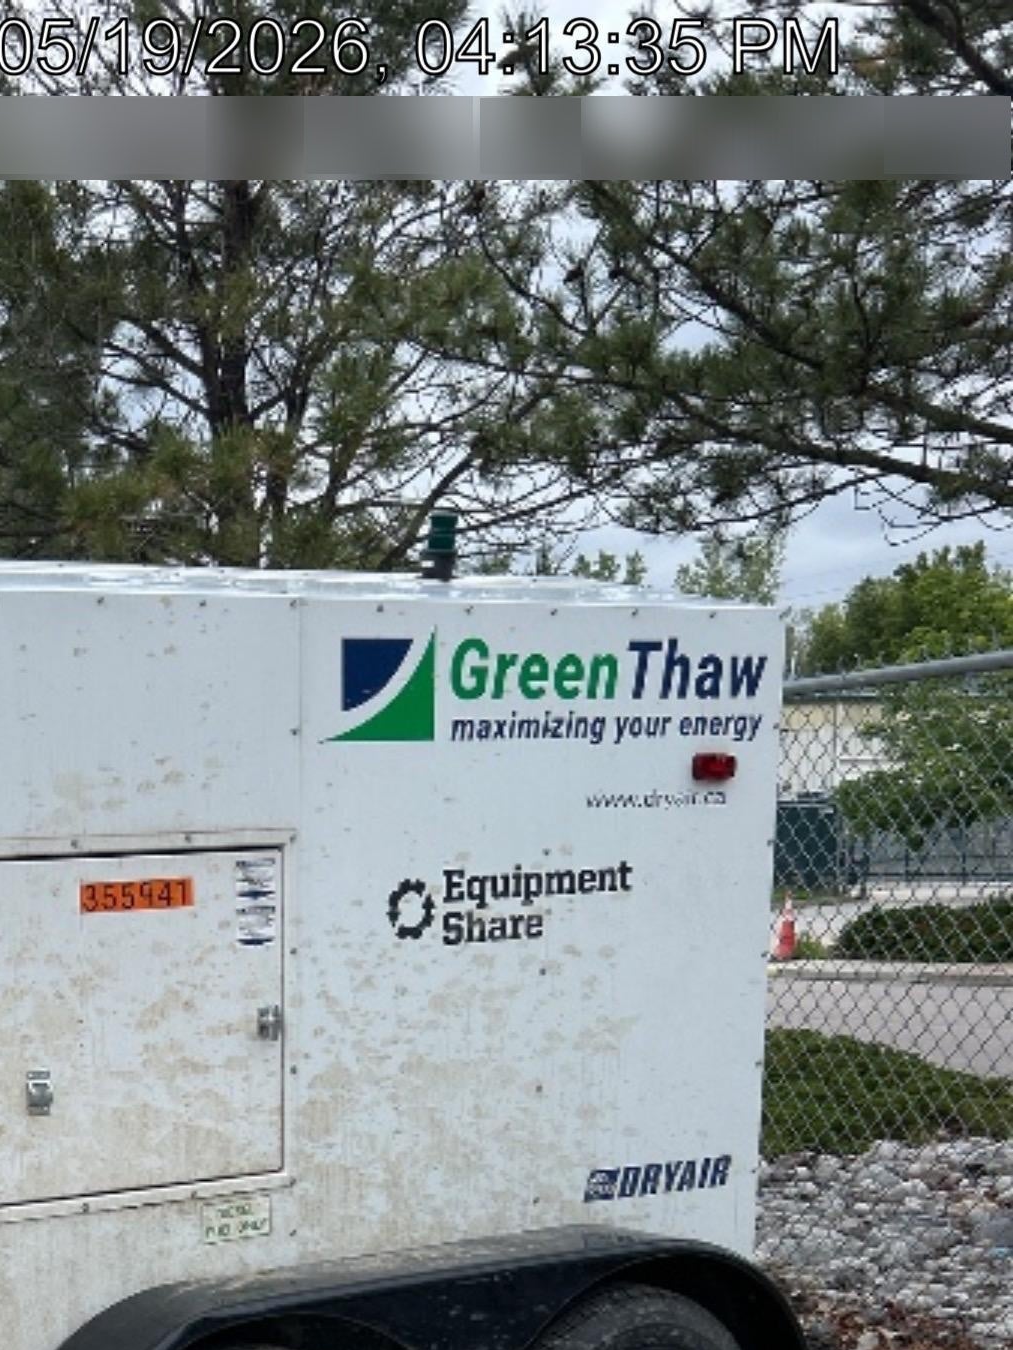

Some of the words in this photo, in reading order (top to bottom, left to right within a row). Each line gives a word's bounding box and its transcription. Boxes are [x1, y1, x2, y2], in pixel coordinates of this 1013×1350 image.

[450, 710, 606, 744] maximizing
[614, 713, 671, 744] your
[678, 711, 763, 742] energy
[443, 860, 633, 909] Equipment
[442, 911, 543, 945] Share
[618, 1154, 732, 1199] DRYAIR
